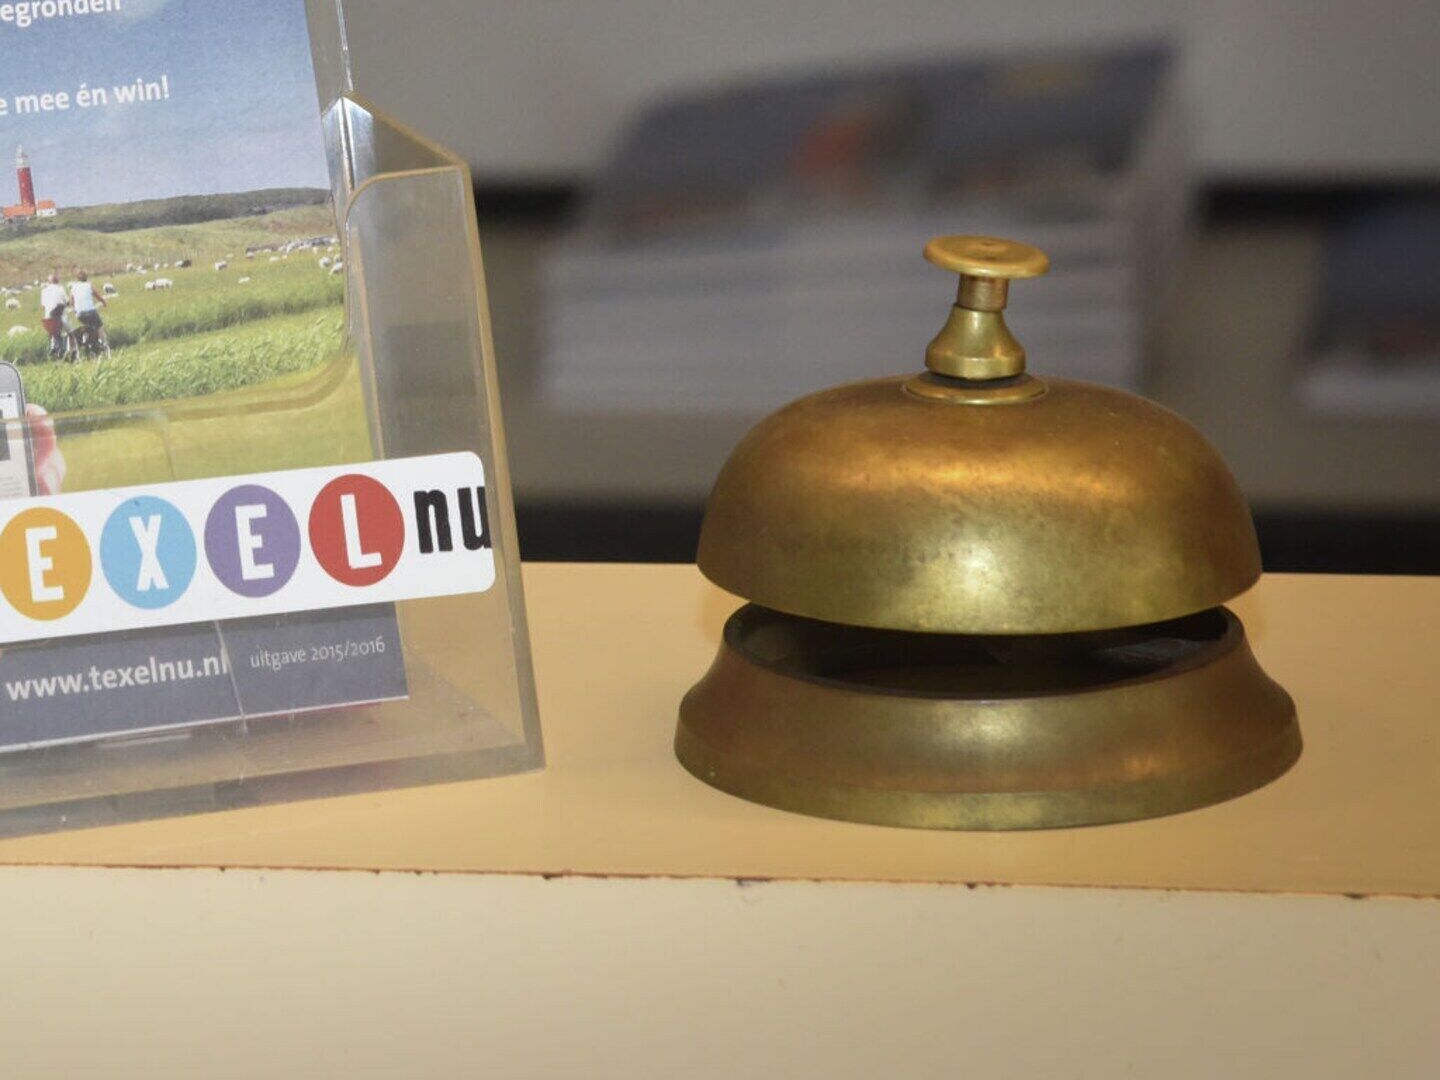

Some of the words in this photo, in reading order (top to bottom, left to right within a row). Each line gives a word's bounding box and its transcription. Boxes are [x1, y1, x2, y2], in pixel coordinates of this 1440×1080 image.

[14, 91, 69, 113] mee
[75, 82, 108, 107] én
[113, 74, 169, 103] win!
[413, 486, 492, 554] nu
[6, 652, 232, 702] www.texelnu.nl
[249, 648, 306, 671] uitgave
[310, 635, 385, 663] 2015/2016
